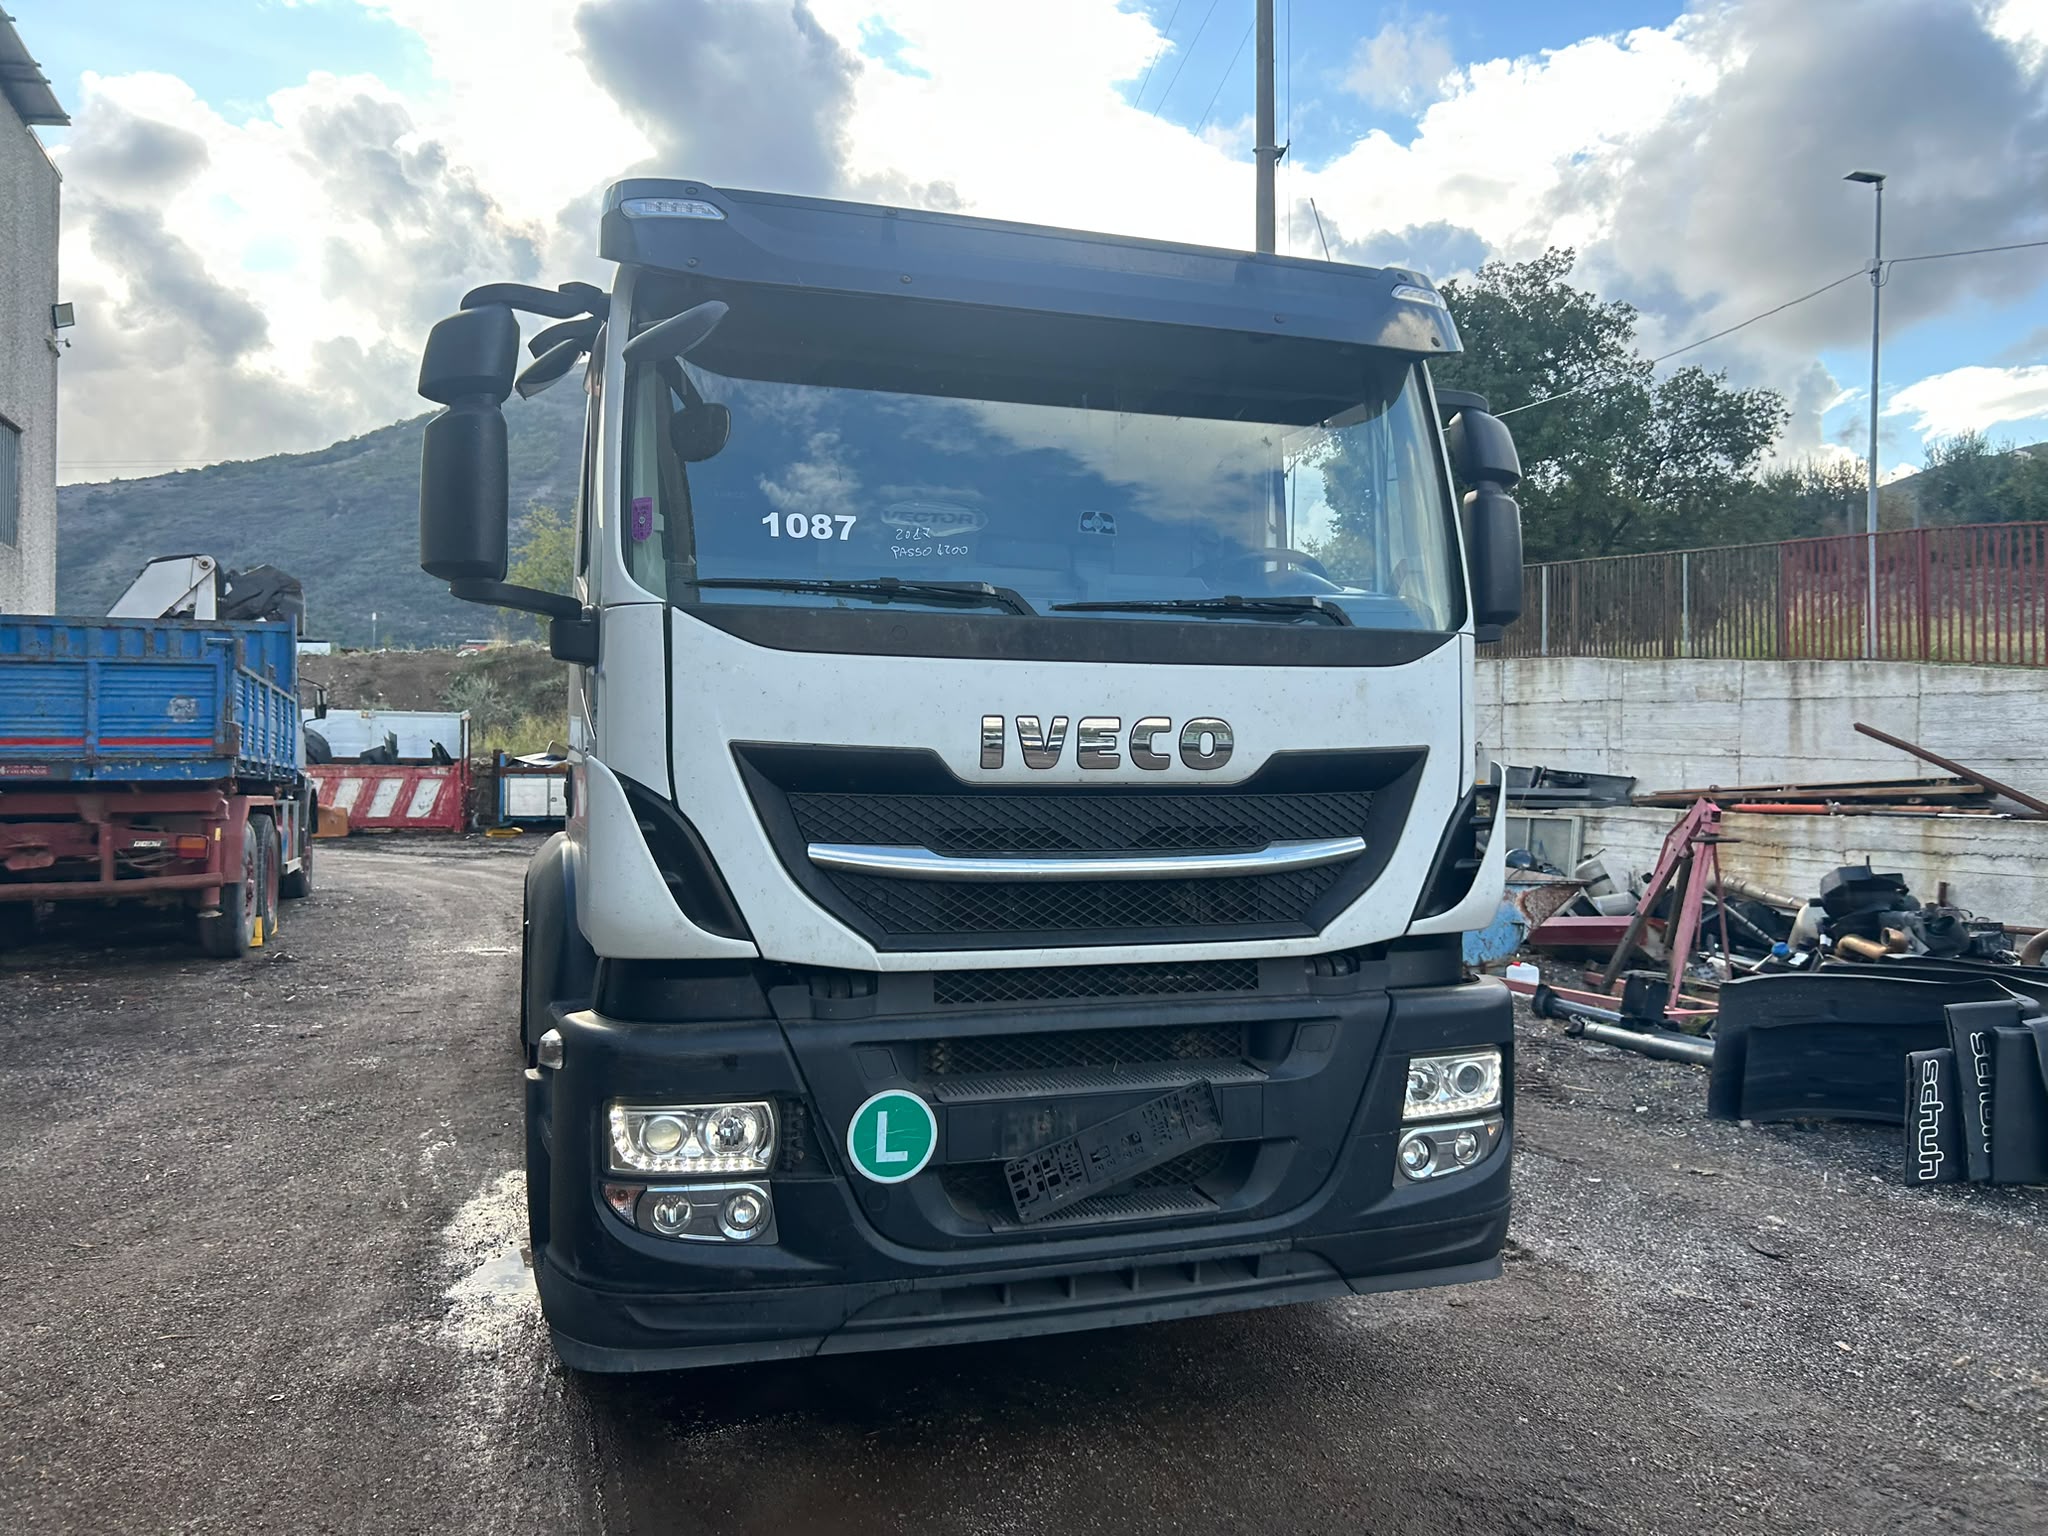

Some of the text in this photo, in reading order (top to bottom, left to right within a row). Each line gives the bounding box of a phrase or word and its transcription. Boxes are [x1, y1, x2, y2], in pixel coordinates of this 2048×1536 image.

[762, 512, 857, 540] 1087
[895, 527, 931, 540] 2017
[890, 545, 932, 559] PASSO
[979, 714, 1234, 770] IVECO
[875, 1110, 909, 1163] L
[1918, 1059, 1944, 1180] schuh
